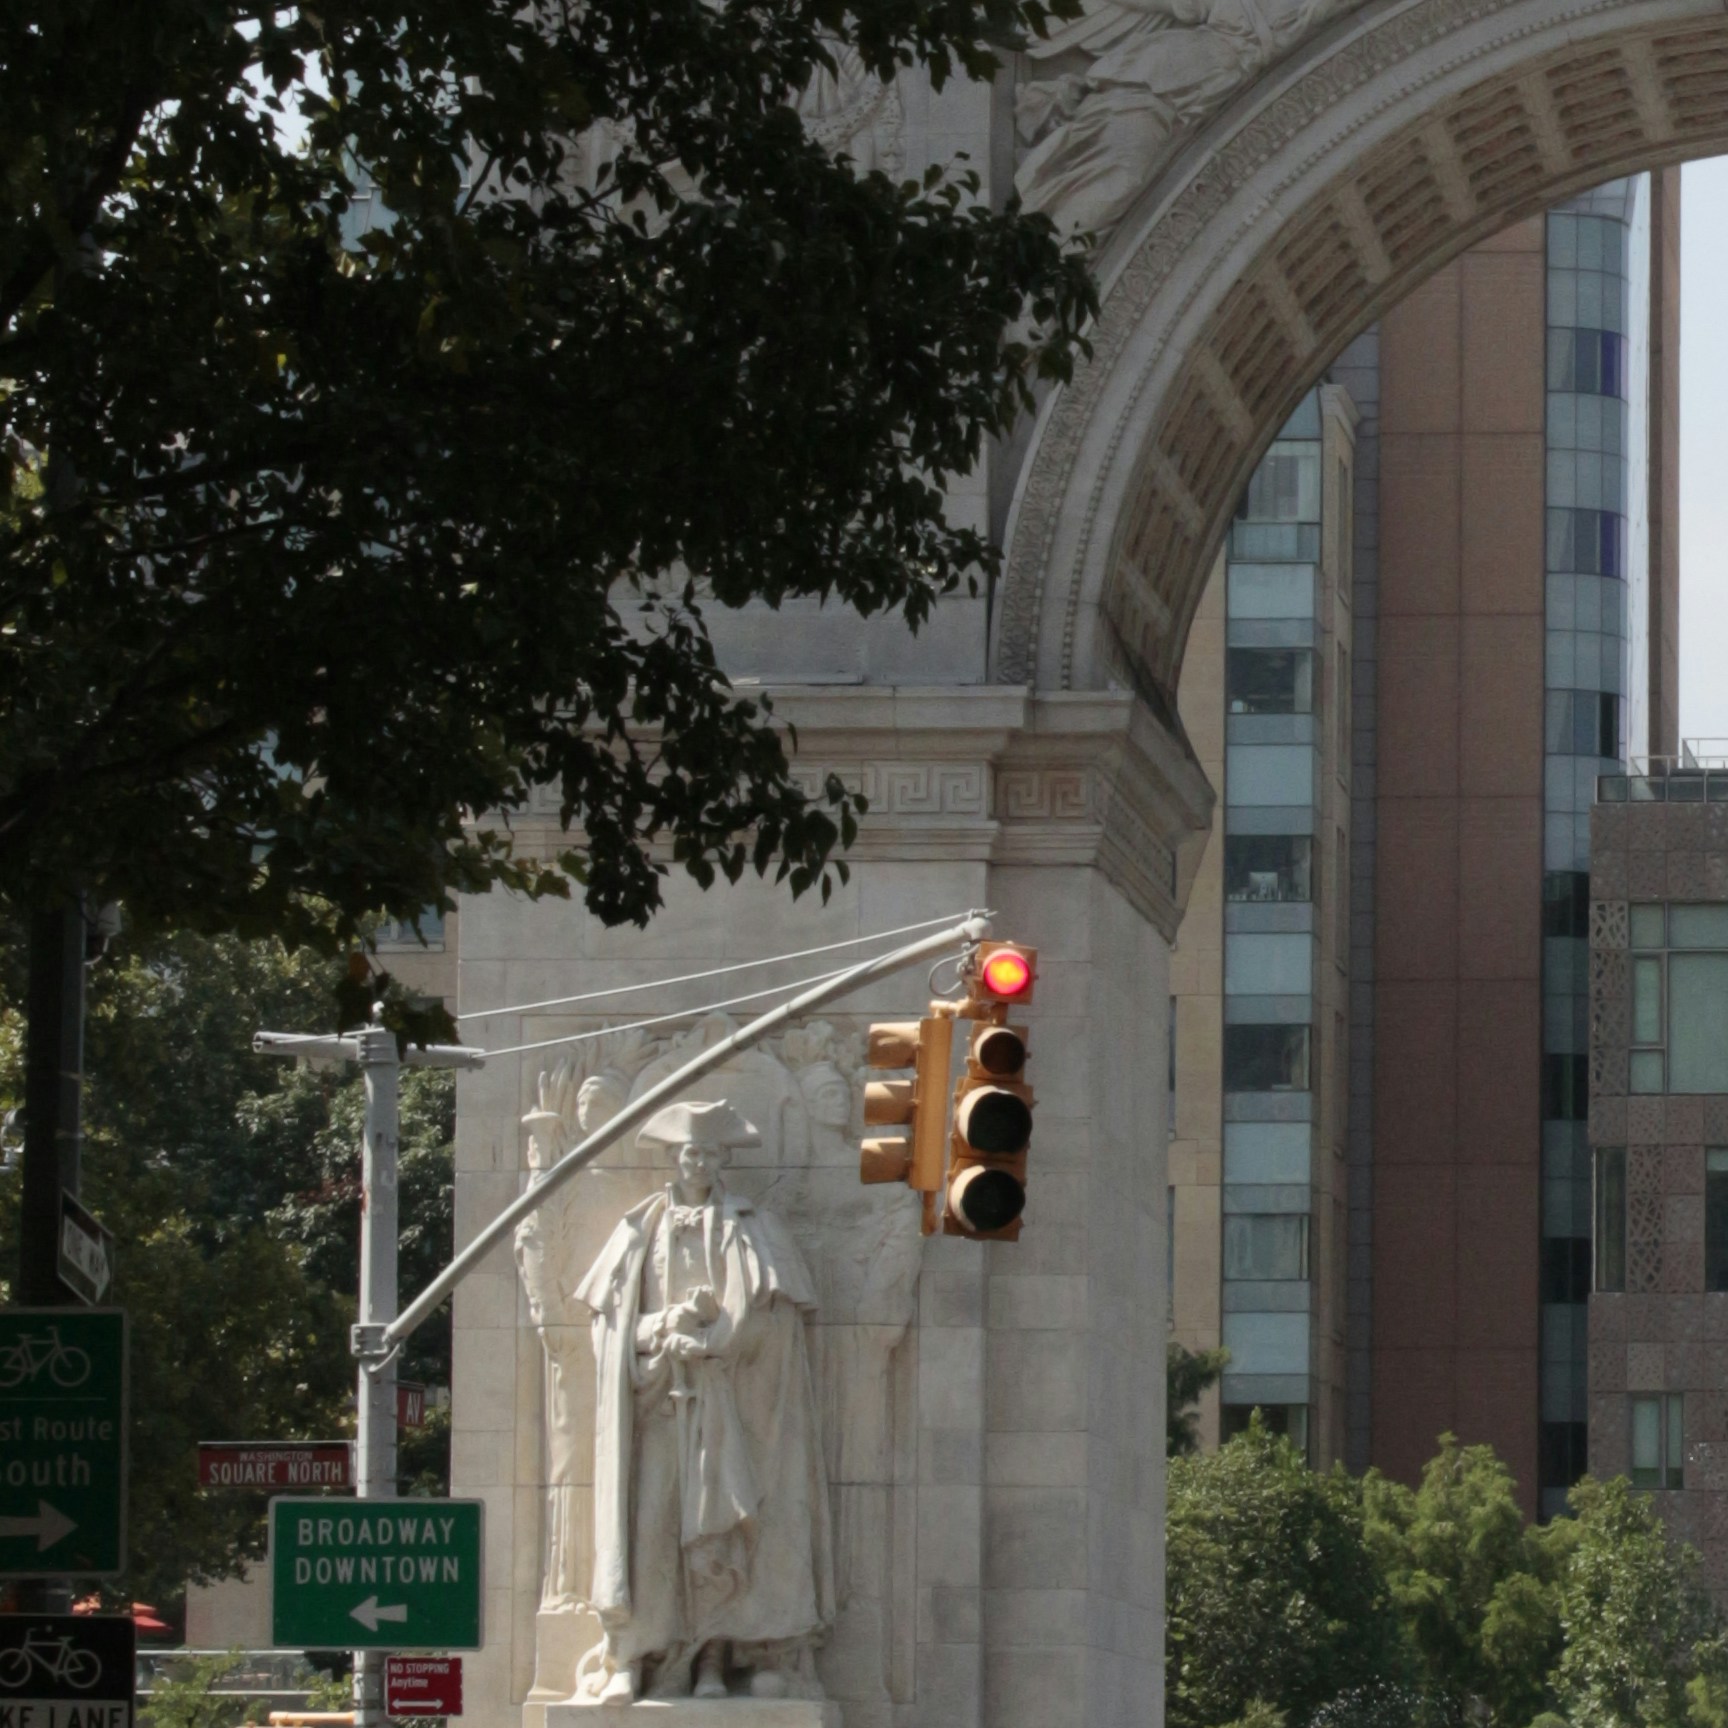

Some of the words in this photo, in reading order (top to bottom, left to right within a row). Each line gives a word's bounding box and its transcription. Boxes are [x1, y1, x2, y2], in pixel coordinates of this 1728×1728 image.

[406, 1392, 421, 1425] AV
[34, 1416, 113, 1441] Route
[239, 1451, 313, 1462] WASHINGTON
[209, 1462, 276, 1485] SQUARE
[288, 1461, 342, 1484] NORTH
[297, 1518, 455, 1546] BROADWAY
[296, 1556, 460, 1585] DOWNTOWN
[390, 1663, 403, 1674] NO
[406, 1663, 450, 1674] STOPPING
[391, 1677, 429, 1690] Anytime
